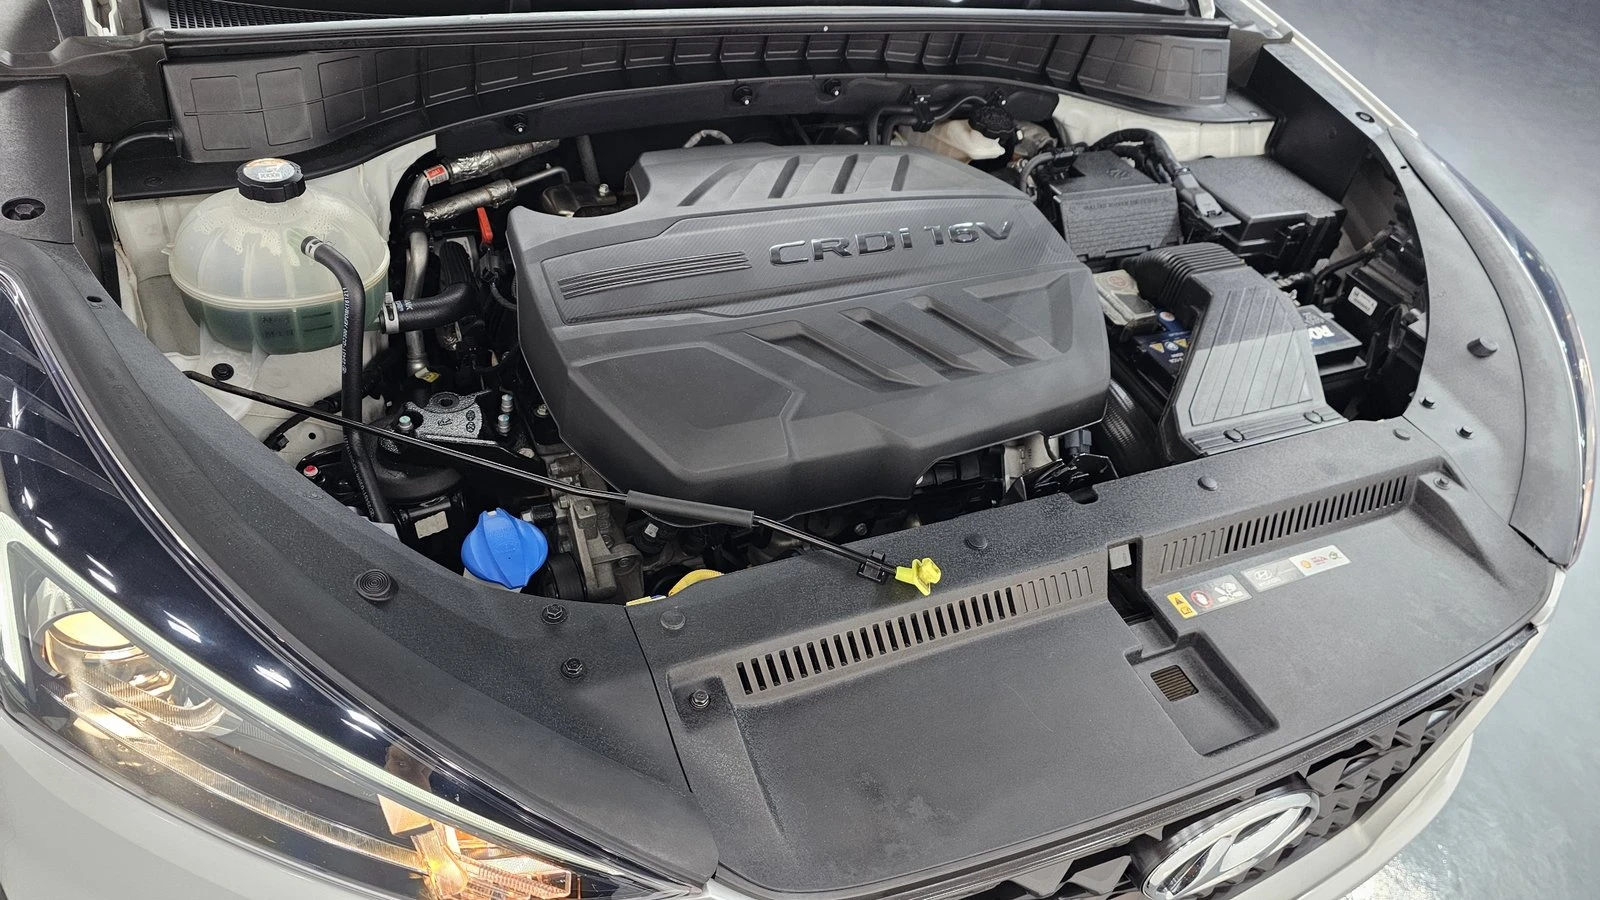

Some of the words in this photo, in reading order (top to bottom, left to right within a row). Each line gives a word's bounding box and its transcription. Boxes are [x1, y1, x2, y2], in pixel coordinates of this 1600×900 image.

[769, 227, 913, 266] CRDi
[923, 220, 1014, 247] 16V
[1308, 325, 1335, 340] RO
